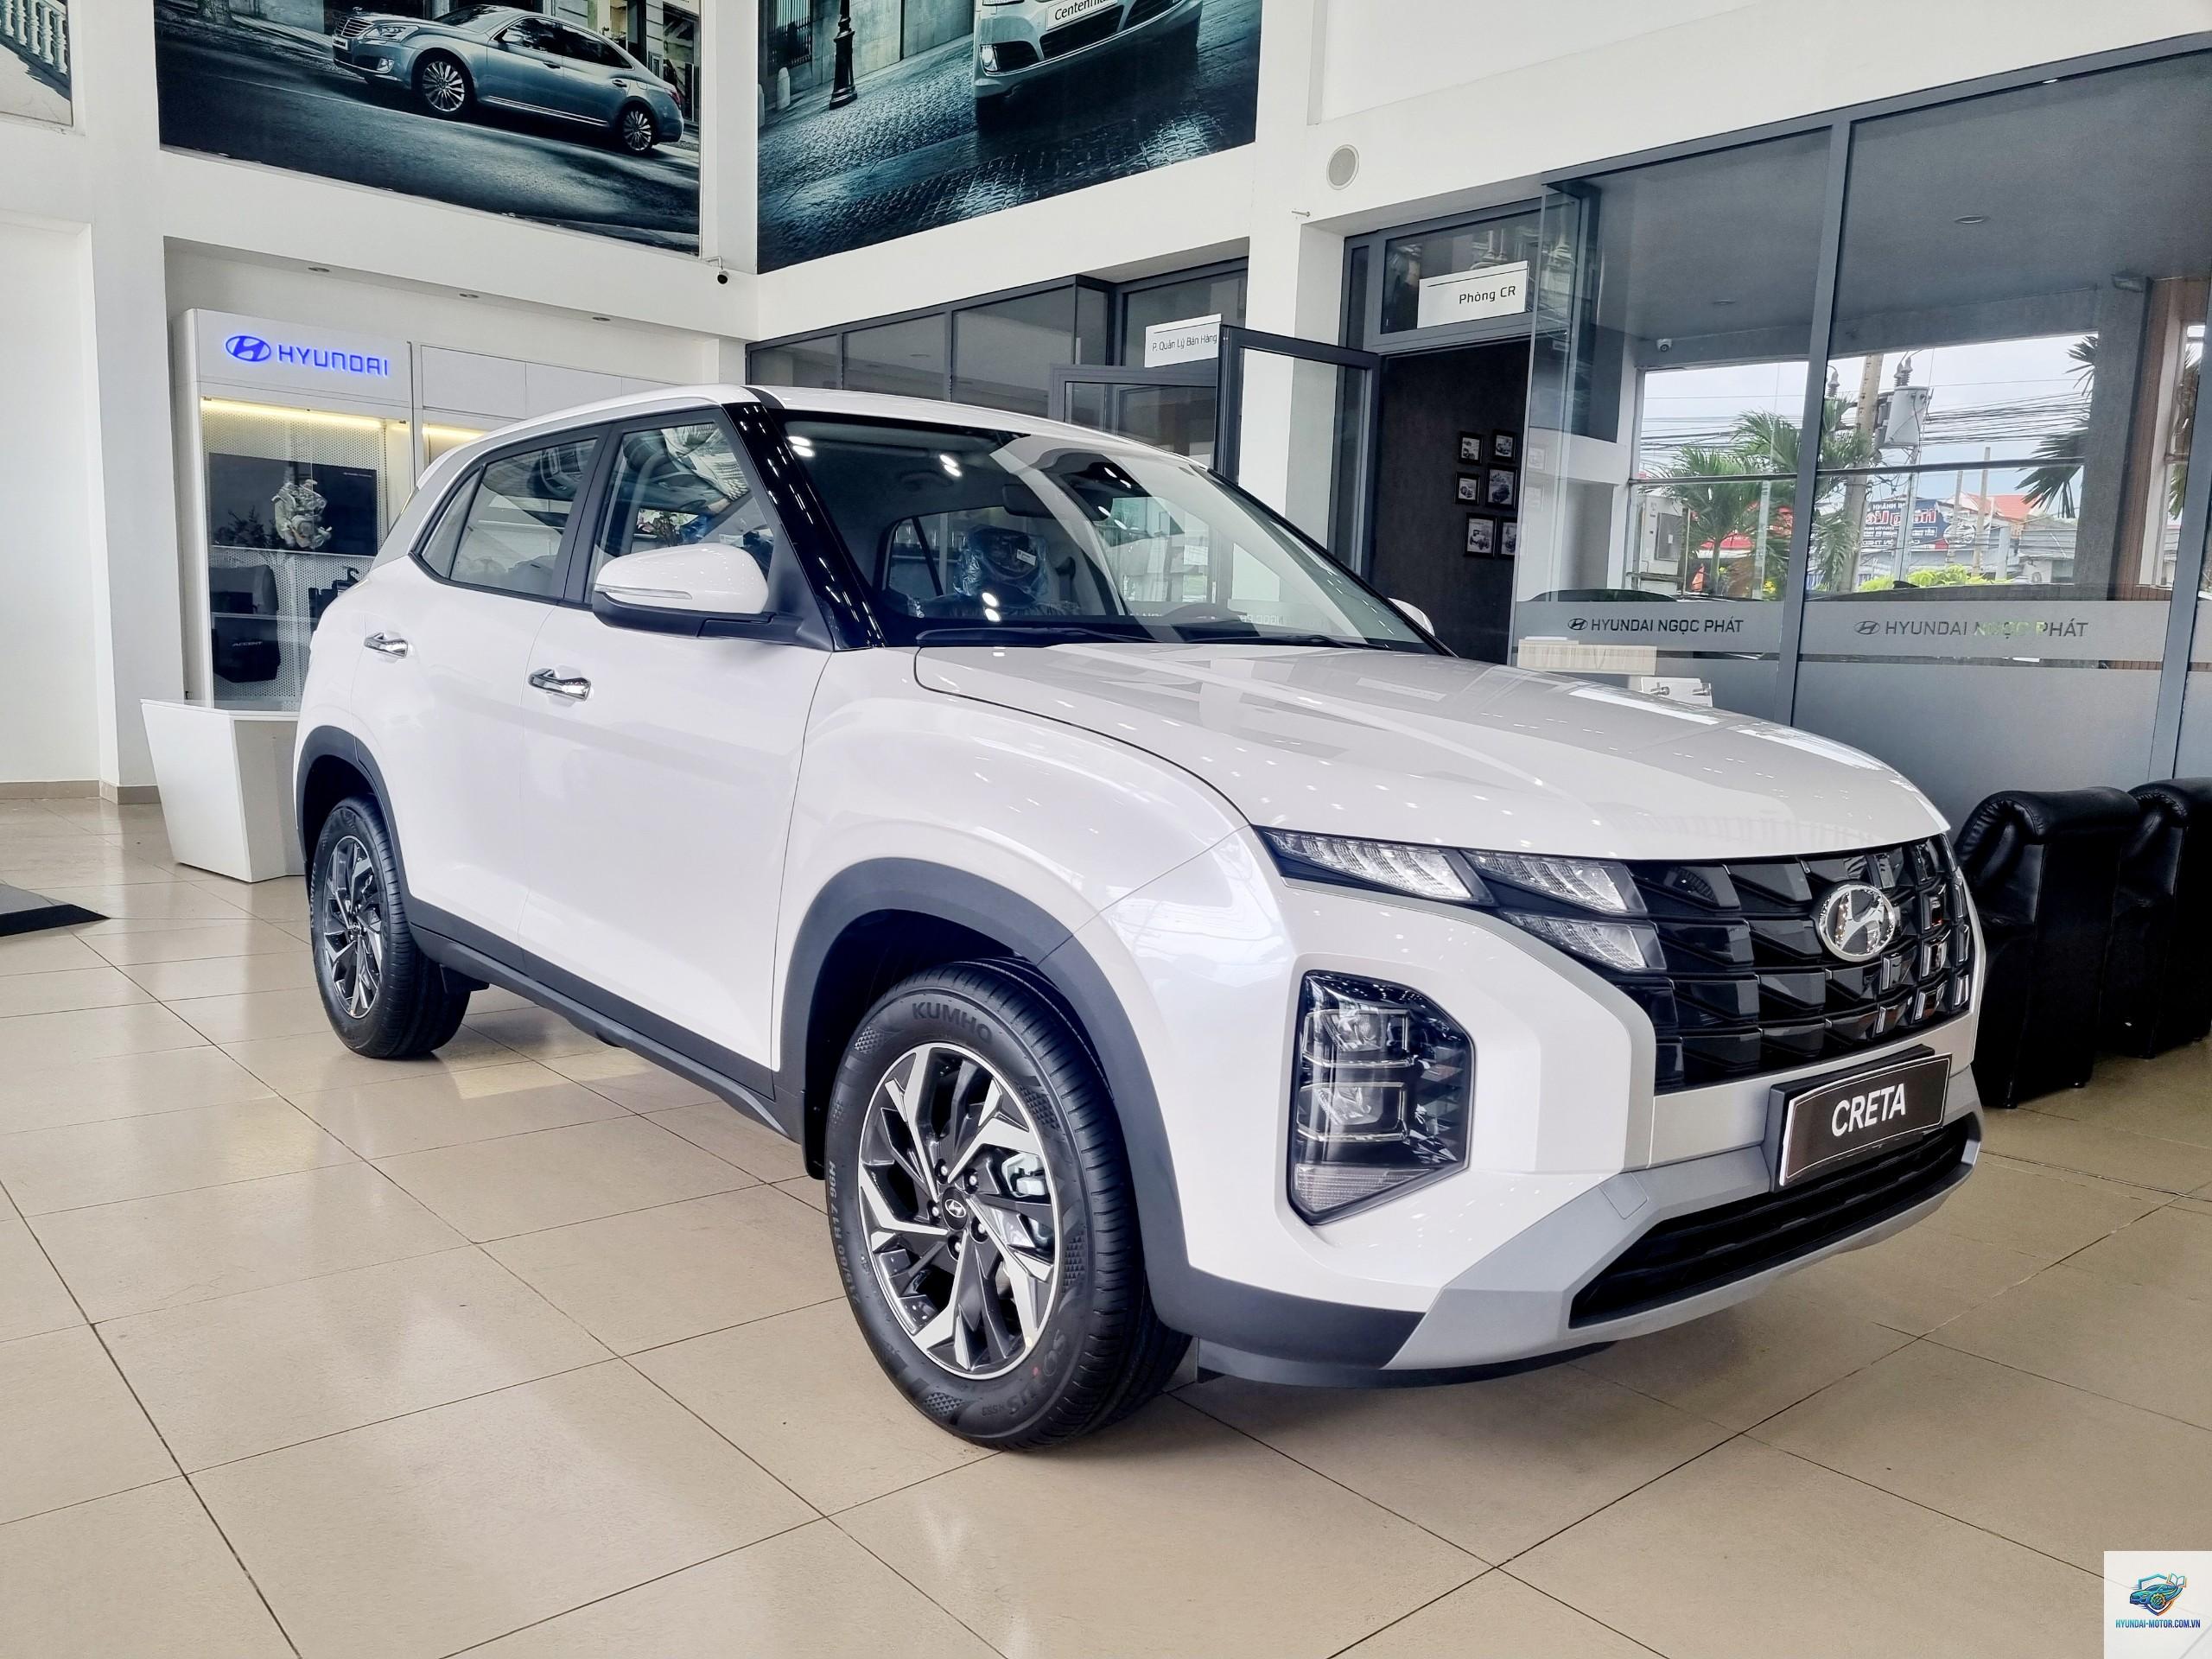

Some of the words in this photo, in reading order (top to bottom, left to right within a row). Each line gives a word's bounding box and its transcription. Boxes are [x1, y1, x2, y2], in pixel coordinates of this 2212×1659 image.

[1459, 290, 1496, 304] Phòng
[1500, 285, 1516, 297] CR
[277, 344, 388, 376] HYUNDAI
[1152, 342, 1158, 352] P.
[1591, 618, 1653, 632] HYUNDAI
[1657, 619, 1700, 635] NGỌC
[1704, 615, 1744, 632] PHÁT
[1885, 620, 1967, 636] HYUNDAI
[2036, 618, 2088, 637] PHÁT
[912, 1001, 993, 1044] KUMHO
[1831, 1083, 1906, 1137] CRETA
[828, 1160, 838, 1199] 96H
[830, 1205, 843, 1240] R17
